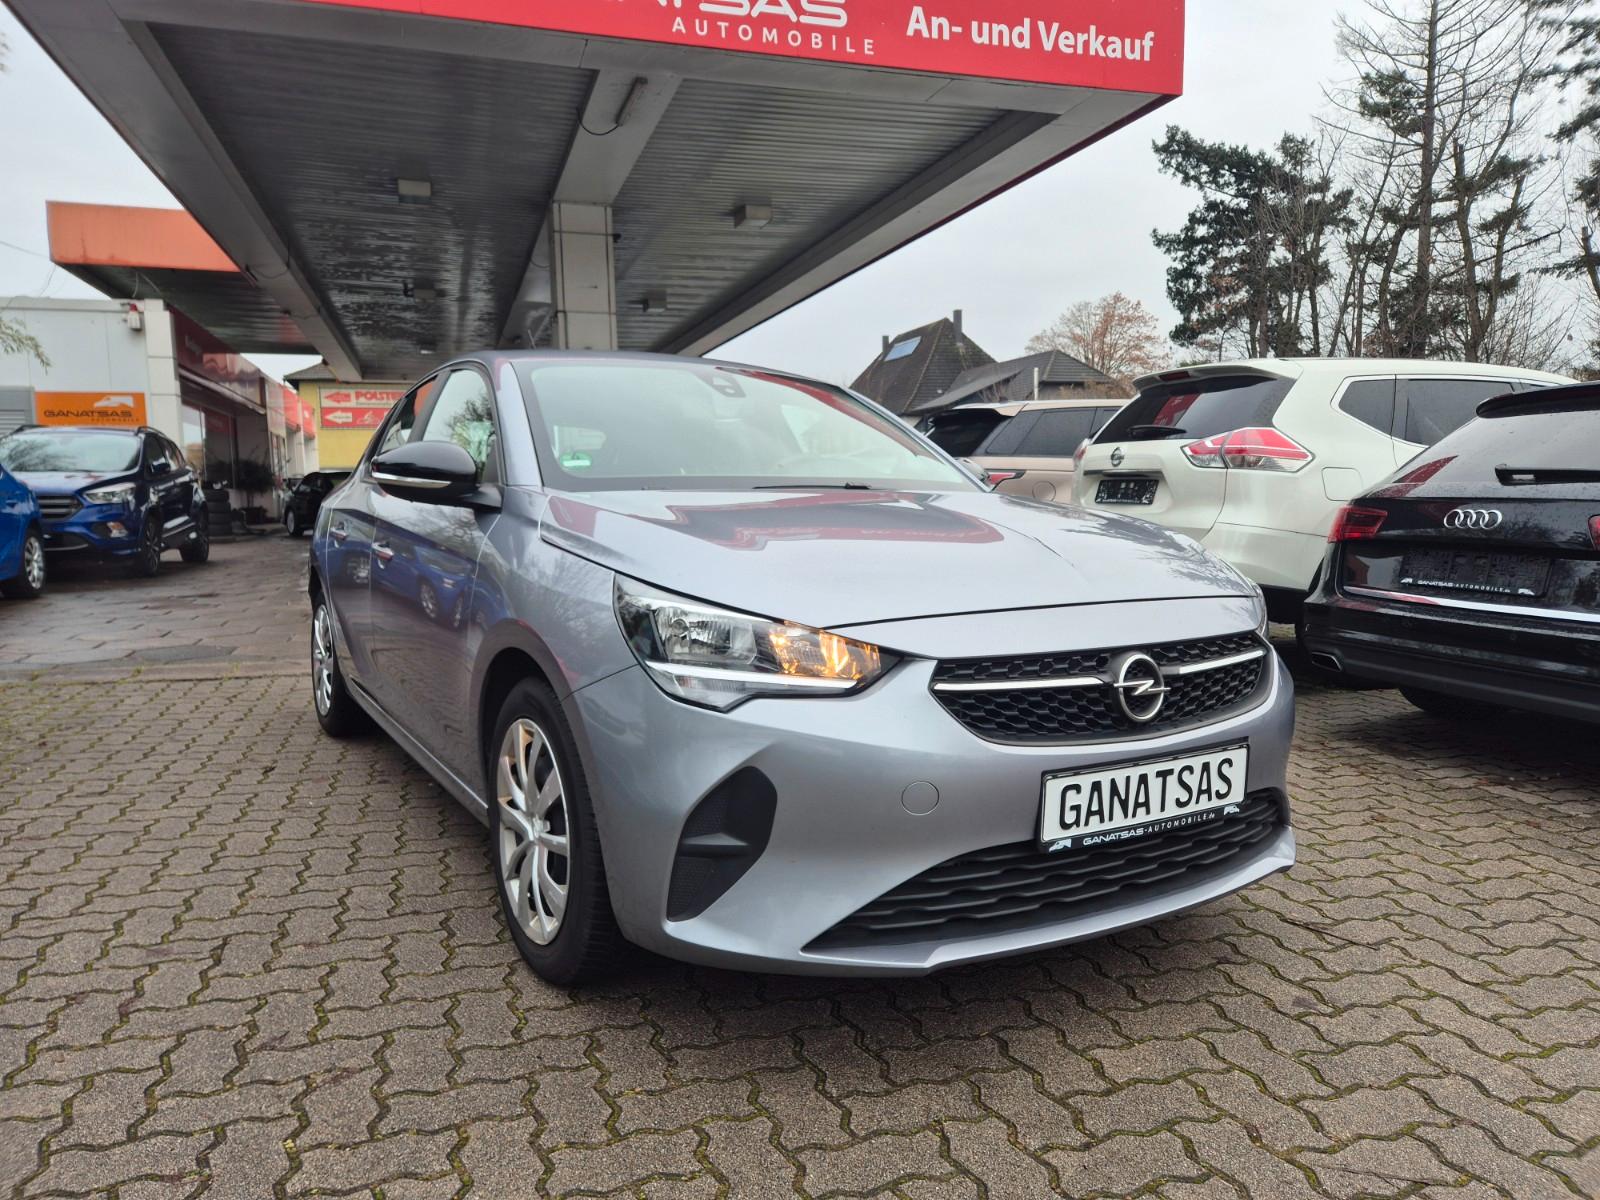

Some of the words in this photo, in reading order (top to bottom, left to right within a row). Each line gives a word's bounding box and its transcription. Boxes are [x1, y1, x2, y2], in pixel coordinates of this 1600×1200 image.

[672, 17, 874, 55] AUTOMOBILE
[906, 5, 962, 40] An-
[971, 18, 1031, 50] und
[1037, 21, 1155, 62] Verkauf
[44, 409, 132, 418] GANATSAS
[1059, 757, 1233, 830] GANATSAS
